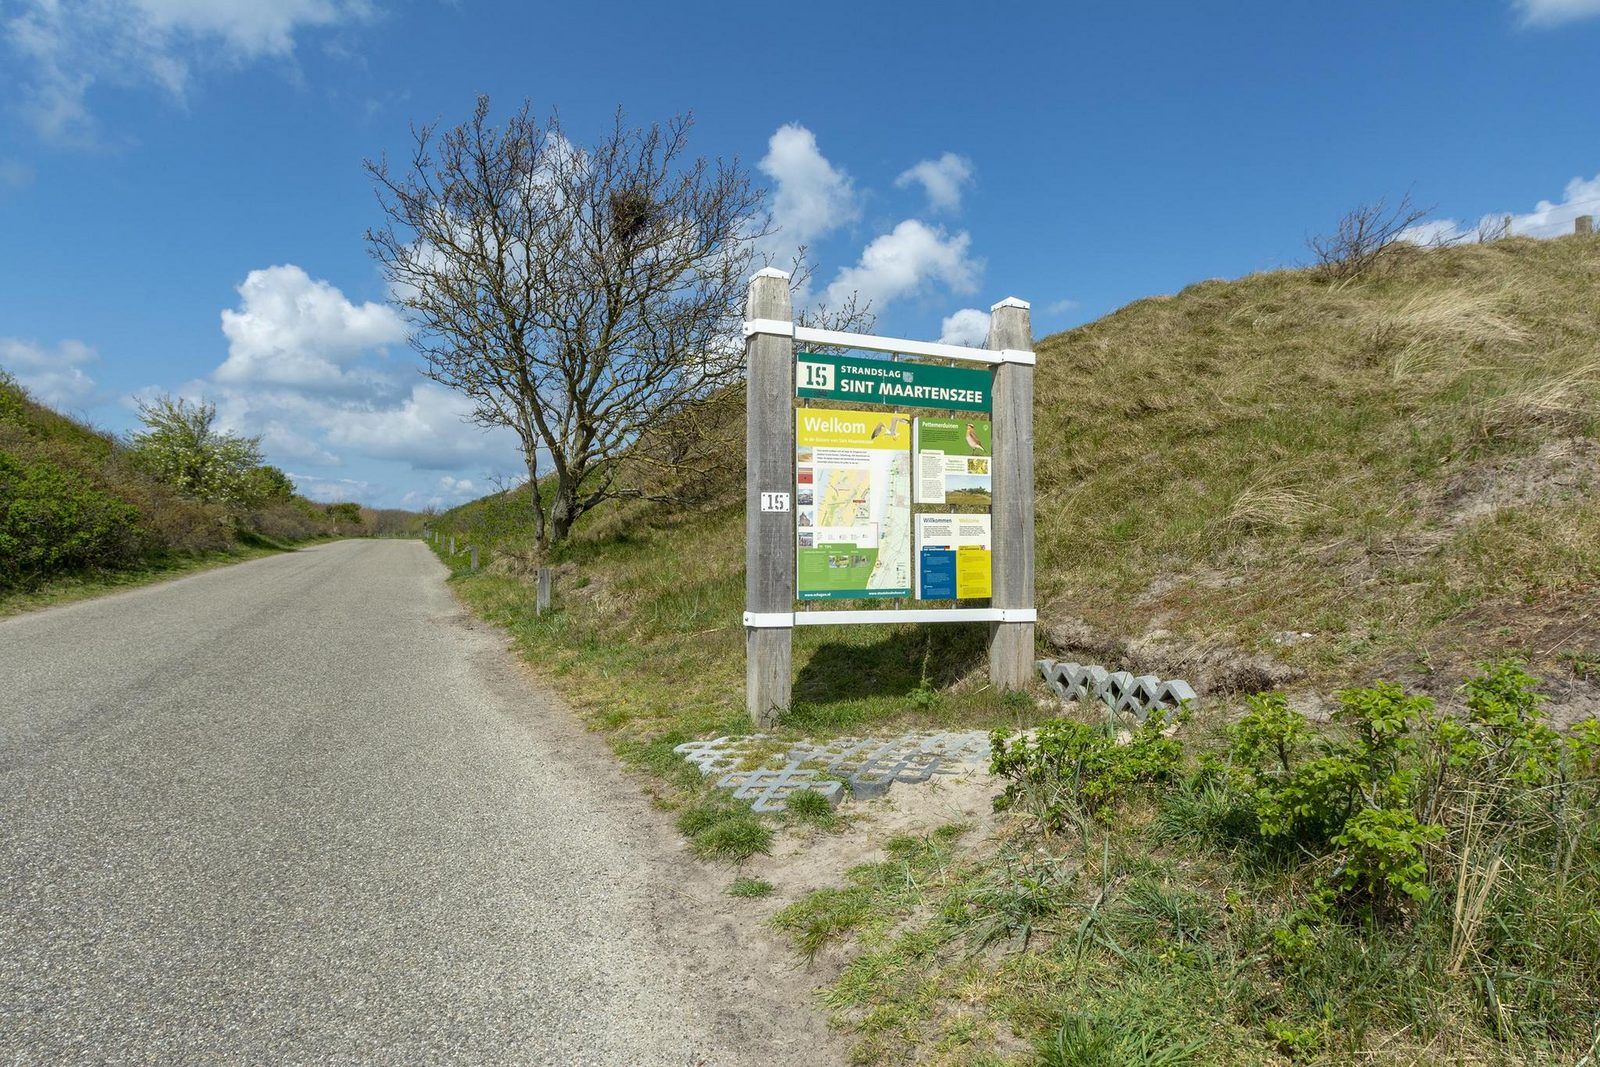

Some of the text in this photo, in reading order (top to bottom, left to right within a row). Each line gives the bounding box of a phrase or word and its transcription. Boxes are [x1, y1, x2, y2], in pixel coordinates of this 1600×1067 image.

[806, 365, 828, 387] 15
[841, 365, 901, 378] STRANDSLAG
[840, 379, 983, 403] SINT MAARTENSZEE
[803, 416, 866, 434] Welkom
[767, 494, 784, 510] 15
